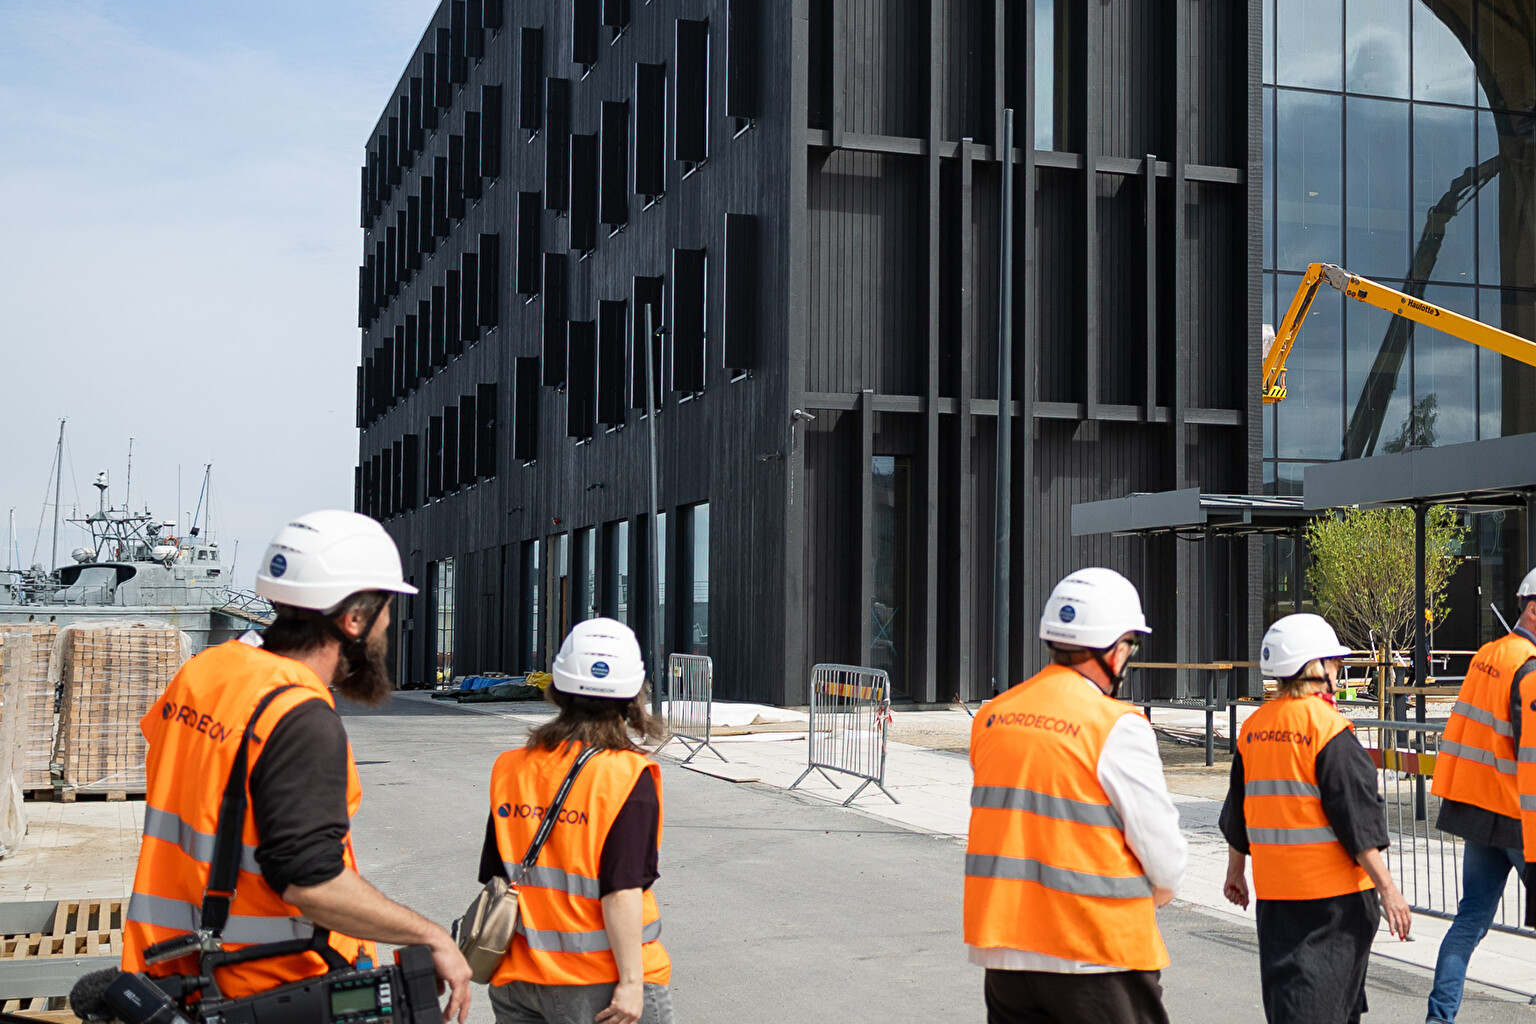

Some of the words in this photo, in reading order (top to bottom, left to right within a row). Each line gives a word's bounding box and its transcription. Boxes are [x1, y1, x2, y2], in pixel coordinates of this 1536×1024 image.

[1407, 299, 1434, 315] Haulotte
[996, 712, 1080, 738] NORDECON
[513, 804, 588, 826] NORCON
